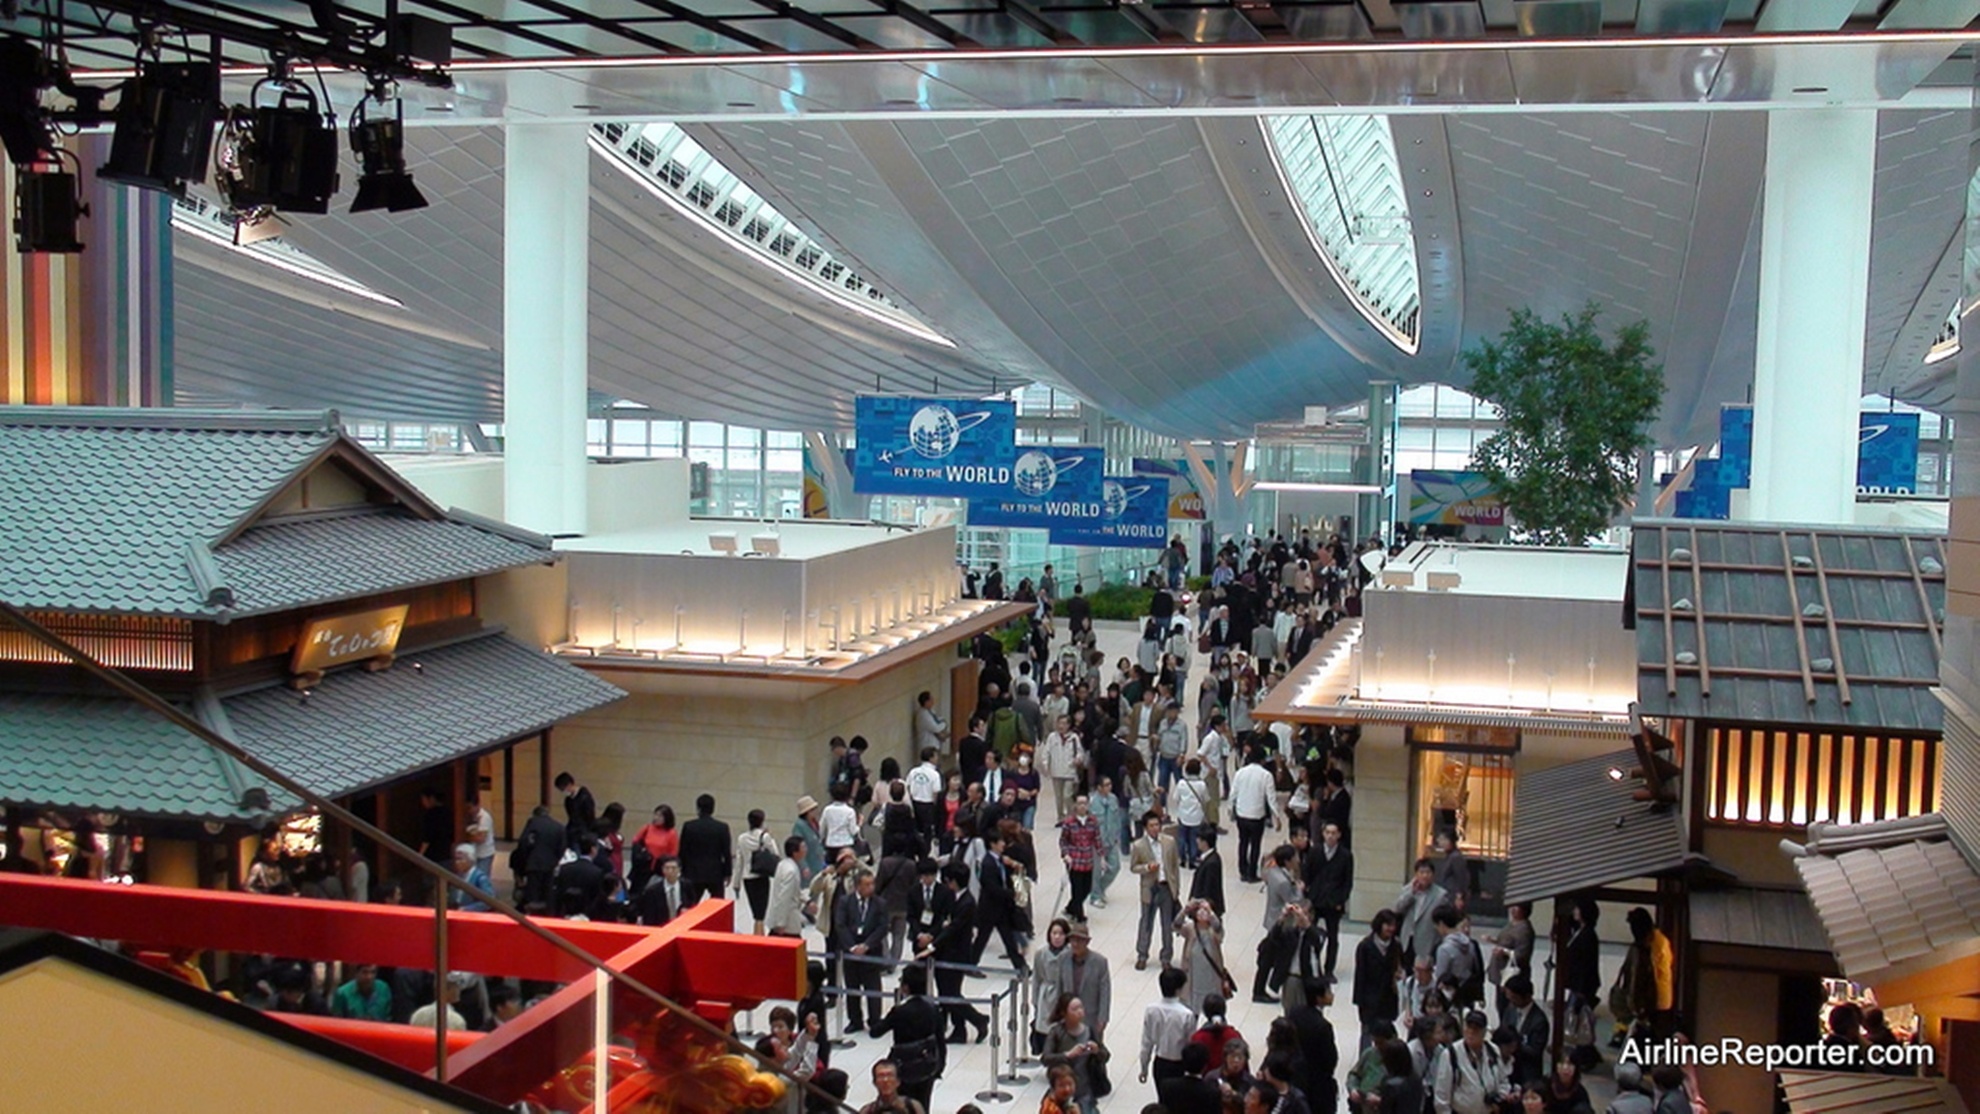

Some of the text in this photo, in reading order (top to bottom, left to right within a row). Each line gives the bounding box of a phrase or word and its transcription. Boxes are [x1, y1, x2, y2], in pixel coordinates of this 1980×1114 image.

[894, 465, 1010, 484] FLY TO THE WORLD
[1001, 502, 1100, 517] FLY TO THE WORLD
[1454, 506, 1501, 519] WORLD
[1117, 524, 1165, 538] WORLD
